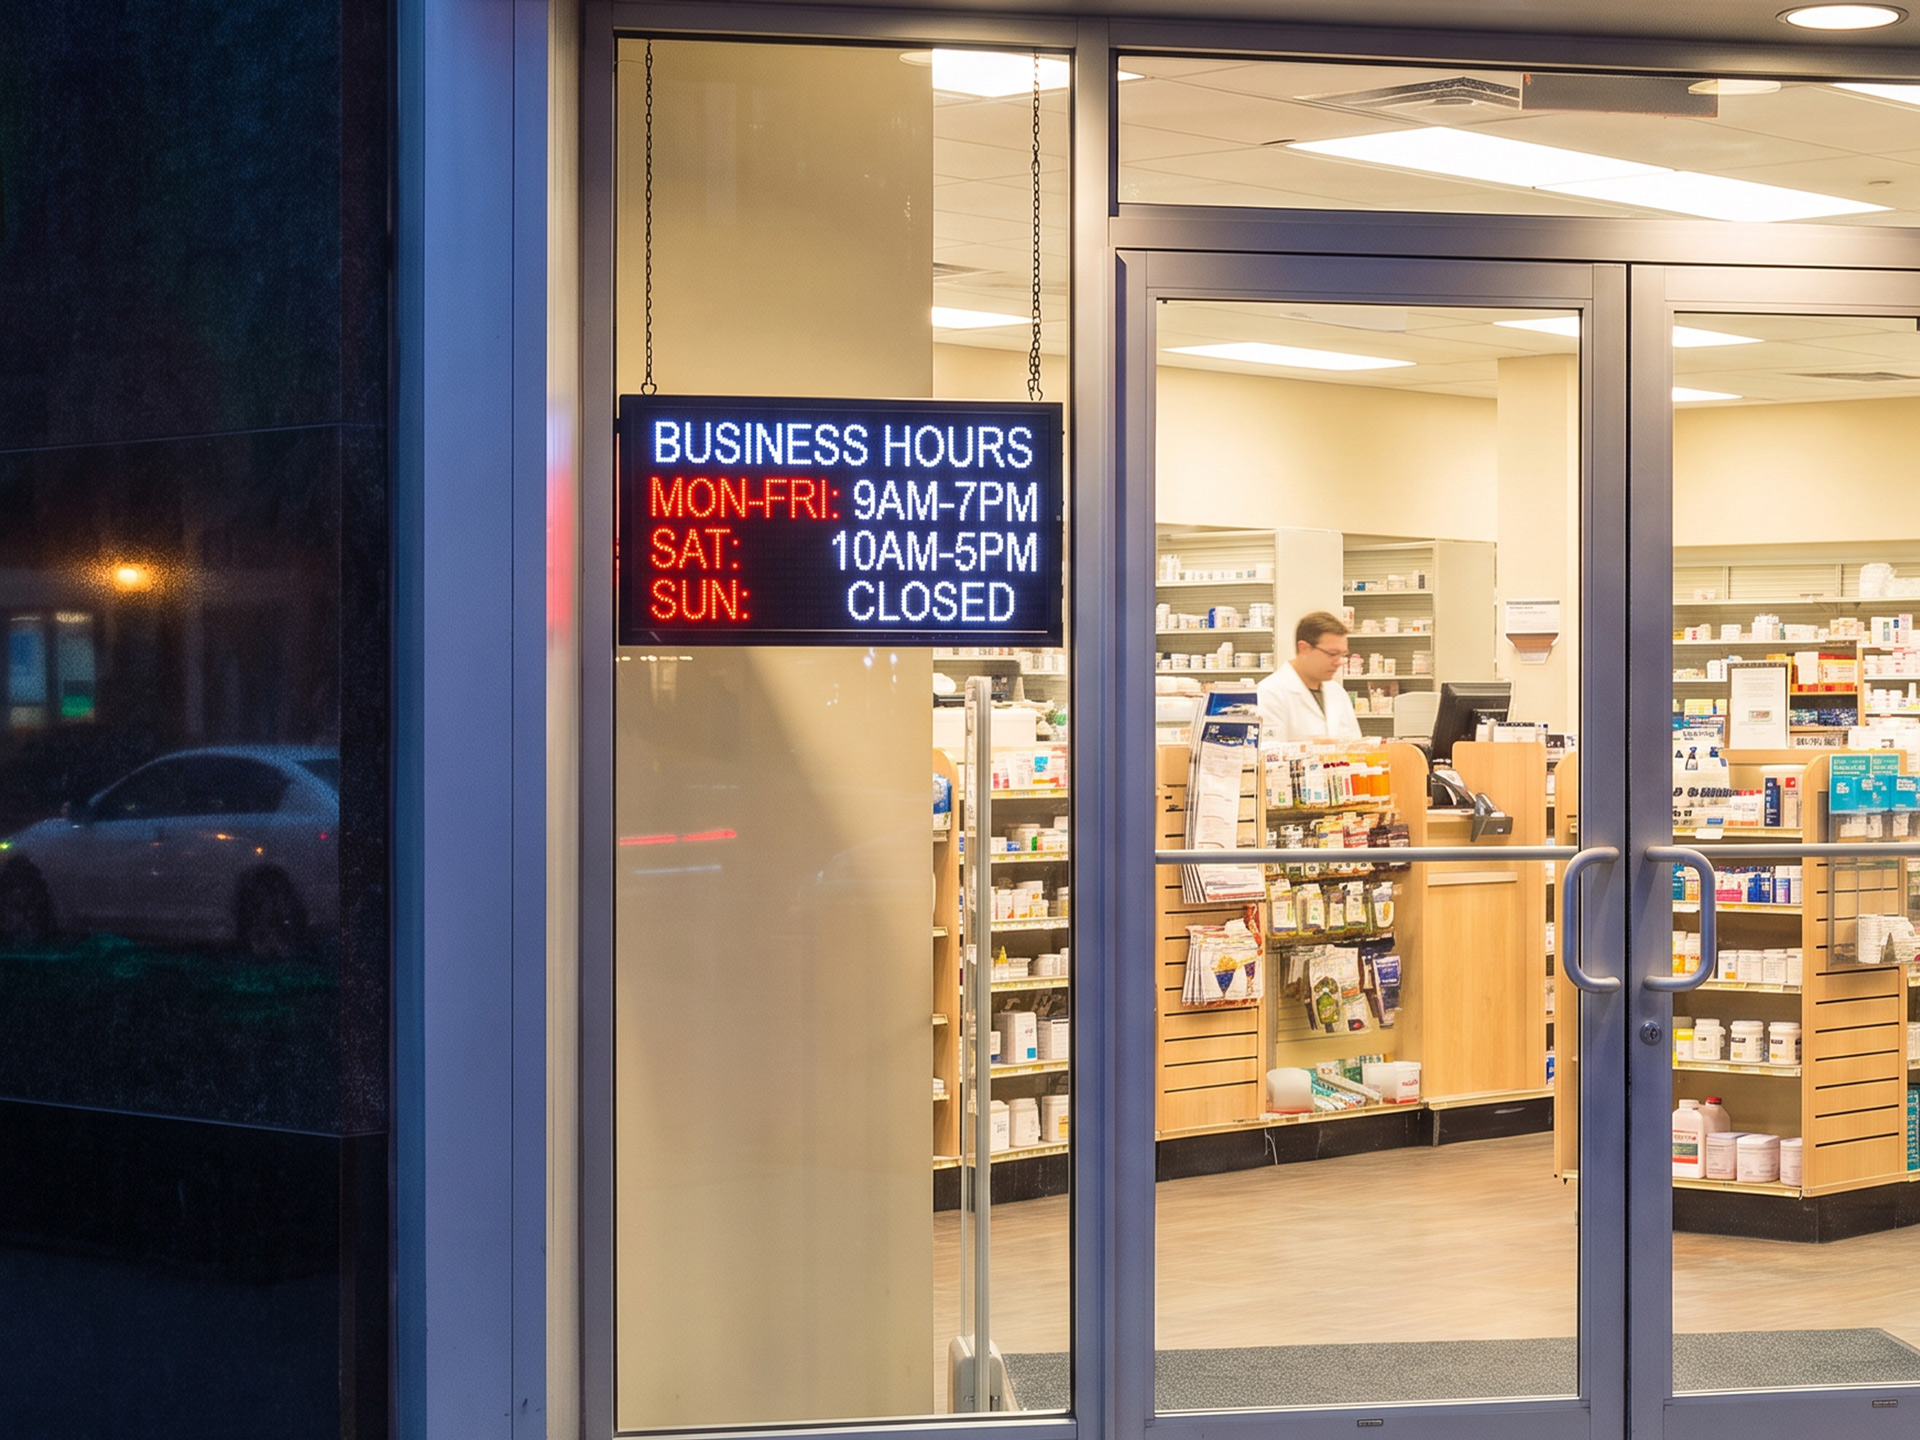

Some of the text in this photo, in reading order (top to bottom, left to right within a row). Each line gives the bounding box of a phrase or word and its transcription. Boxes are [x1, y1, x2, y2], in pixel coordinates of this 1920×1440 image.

[654, 421, 1033, 469] BUSINESS HOURS
[651, 477, 1038, 522] MON-FRI: 9AM-7PM
[651, 528, 1038, 572] SAT: 10AM-5PM
[651, 579, 1015, 622] SUN: CLOSED
